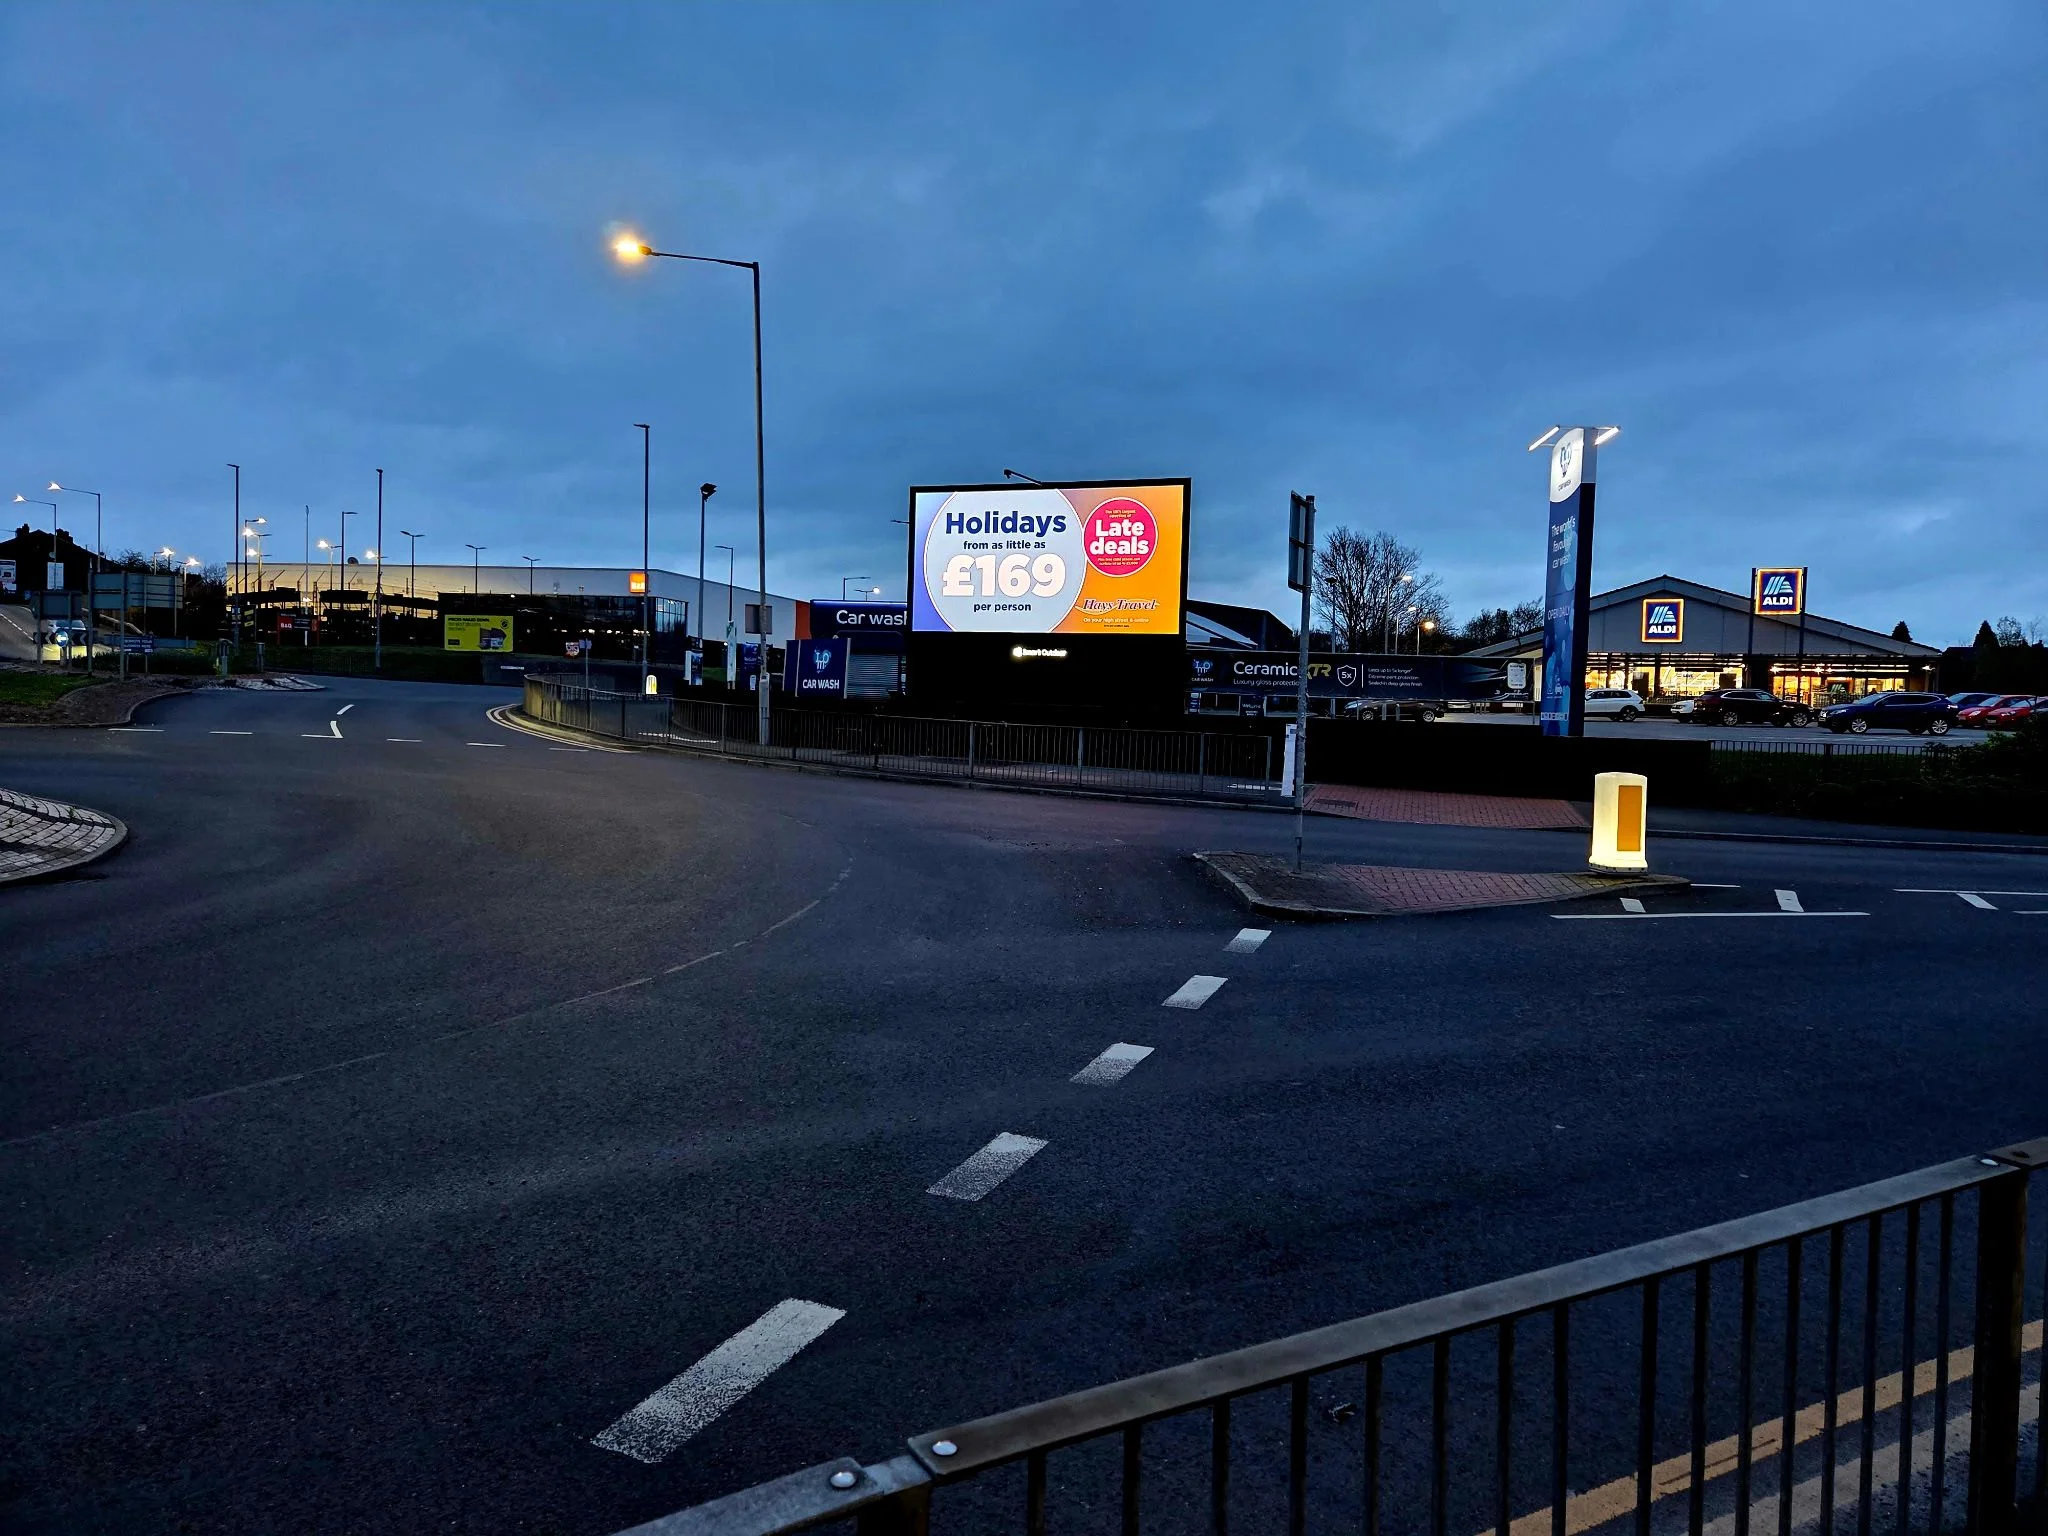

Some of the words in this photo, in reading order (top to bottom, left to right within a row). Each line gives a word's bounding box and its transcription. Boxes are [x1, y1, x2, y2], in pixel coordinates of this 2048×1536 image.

[946, 511, 1066, 538] Holidays
[1095, 519, 1145, 537] Late
[1551, 524, 1559, 538] The
[963, 541, 989, 549] from
[1006, 540, 1031, 549] little
[1034, 541, 1046, 549] as
[1090, 536, 1150, 555] deals
[942, 553, 1066, 597] £169
[973, 604, 991, 612] per
[994, 603, 1032, 612] person
[1083, 599, 1114, 611] Hays
[1117, 599, 1156, 610] Travel
[1762, 596, 1793, 606] ALDI
[836, 609, 866, 625] Car
[1648, 625, 1676, 634] ALDI
[1233, 661, 1298, 676] Ceramic
[1341, 671, 1352, 679] 5x
[802, 679, 817, 689] CAR
[817, 679, 840, 690] WASH
